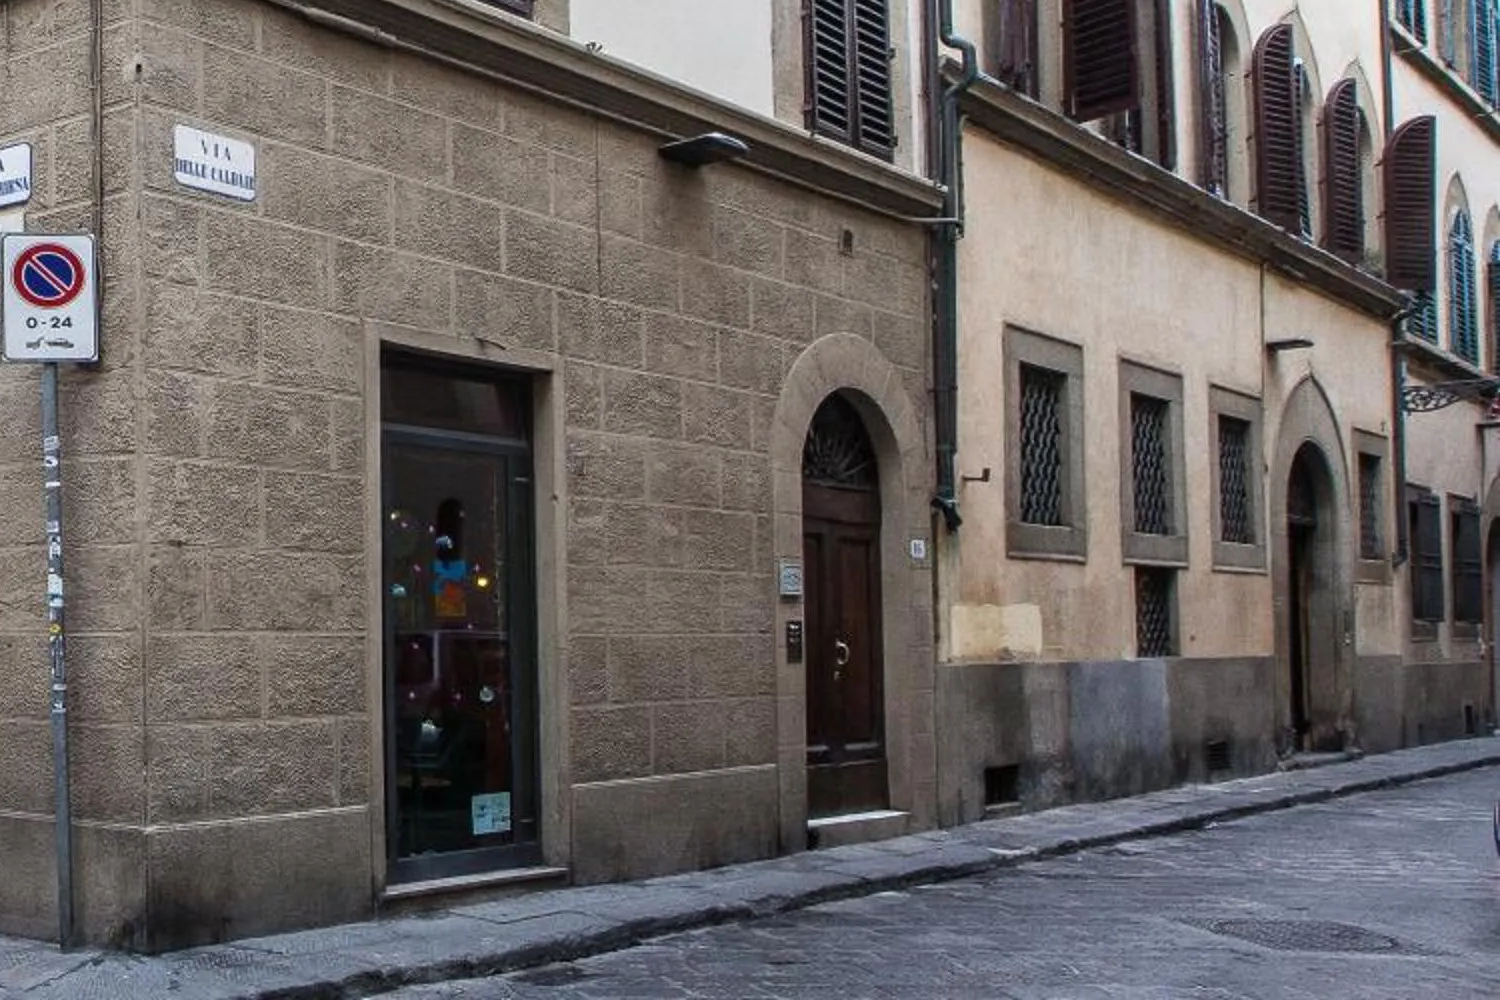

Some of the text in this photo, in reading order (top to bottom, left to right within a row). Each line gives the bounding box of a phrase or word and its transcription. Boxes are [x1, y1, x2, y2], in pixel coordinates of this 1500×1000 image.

[201, 139, 231, 161] VIA
[175, 157, 207, 179] DELLE
[50, 315, 73, 329] 24
